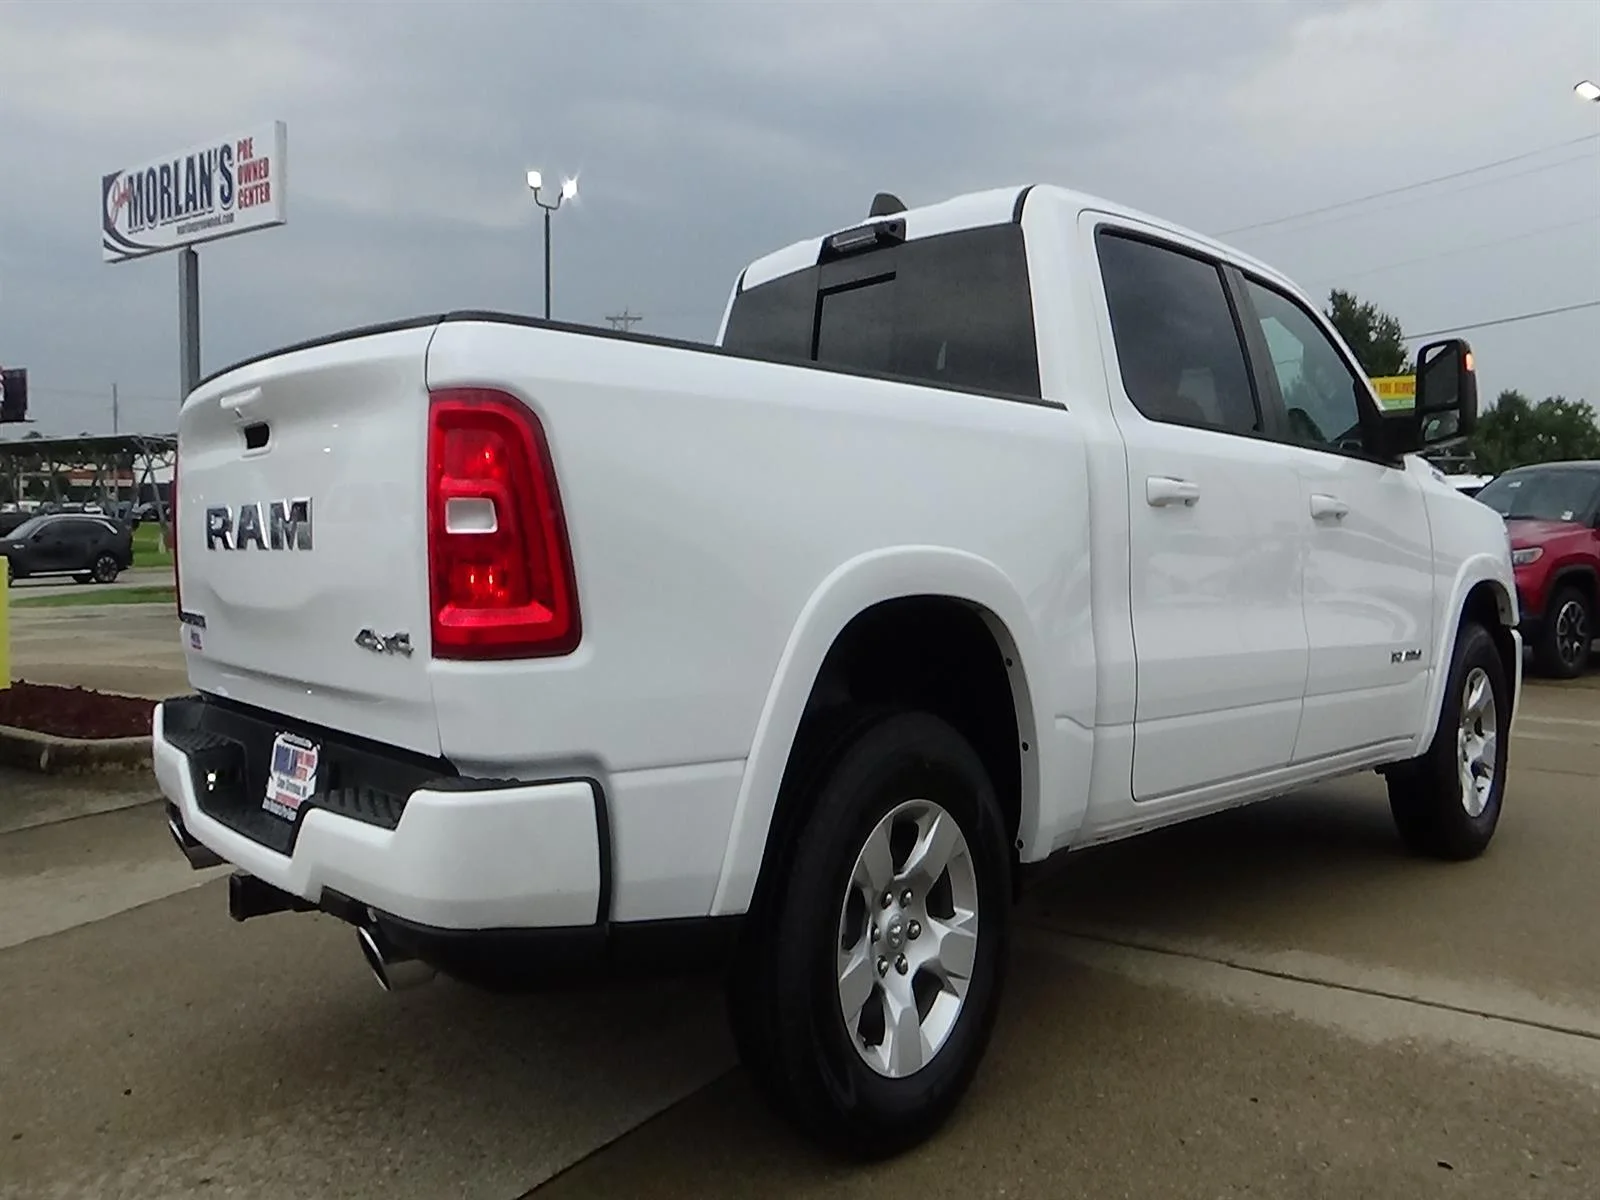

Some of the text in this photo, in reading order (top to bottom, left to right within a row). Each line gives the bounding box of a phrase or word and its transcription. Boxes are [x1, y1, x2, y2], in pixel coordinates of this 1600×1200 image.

[237, 137, 253, 162] PRE
[238, 157, 269, 186] OWNED
[128, 144, 233, 229] MORLAN'S
[238, 182, 270, 210] CENTER
[206, 497, 313, 550] RAM
